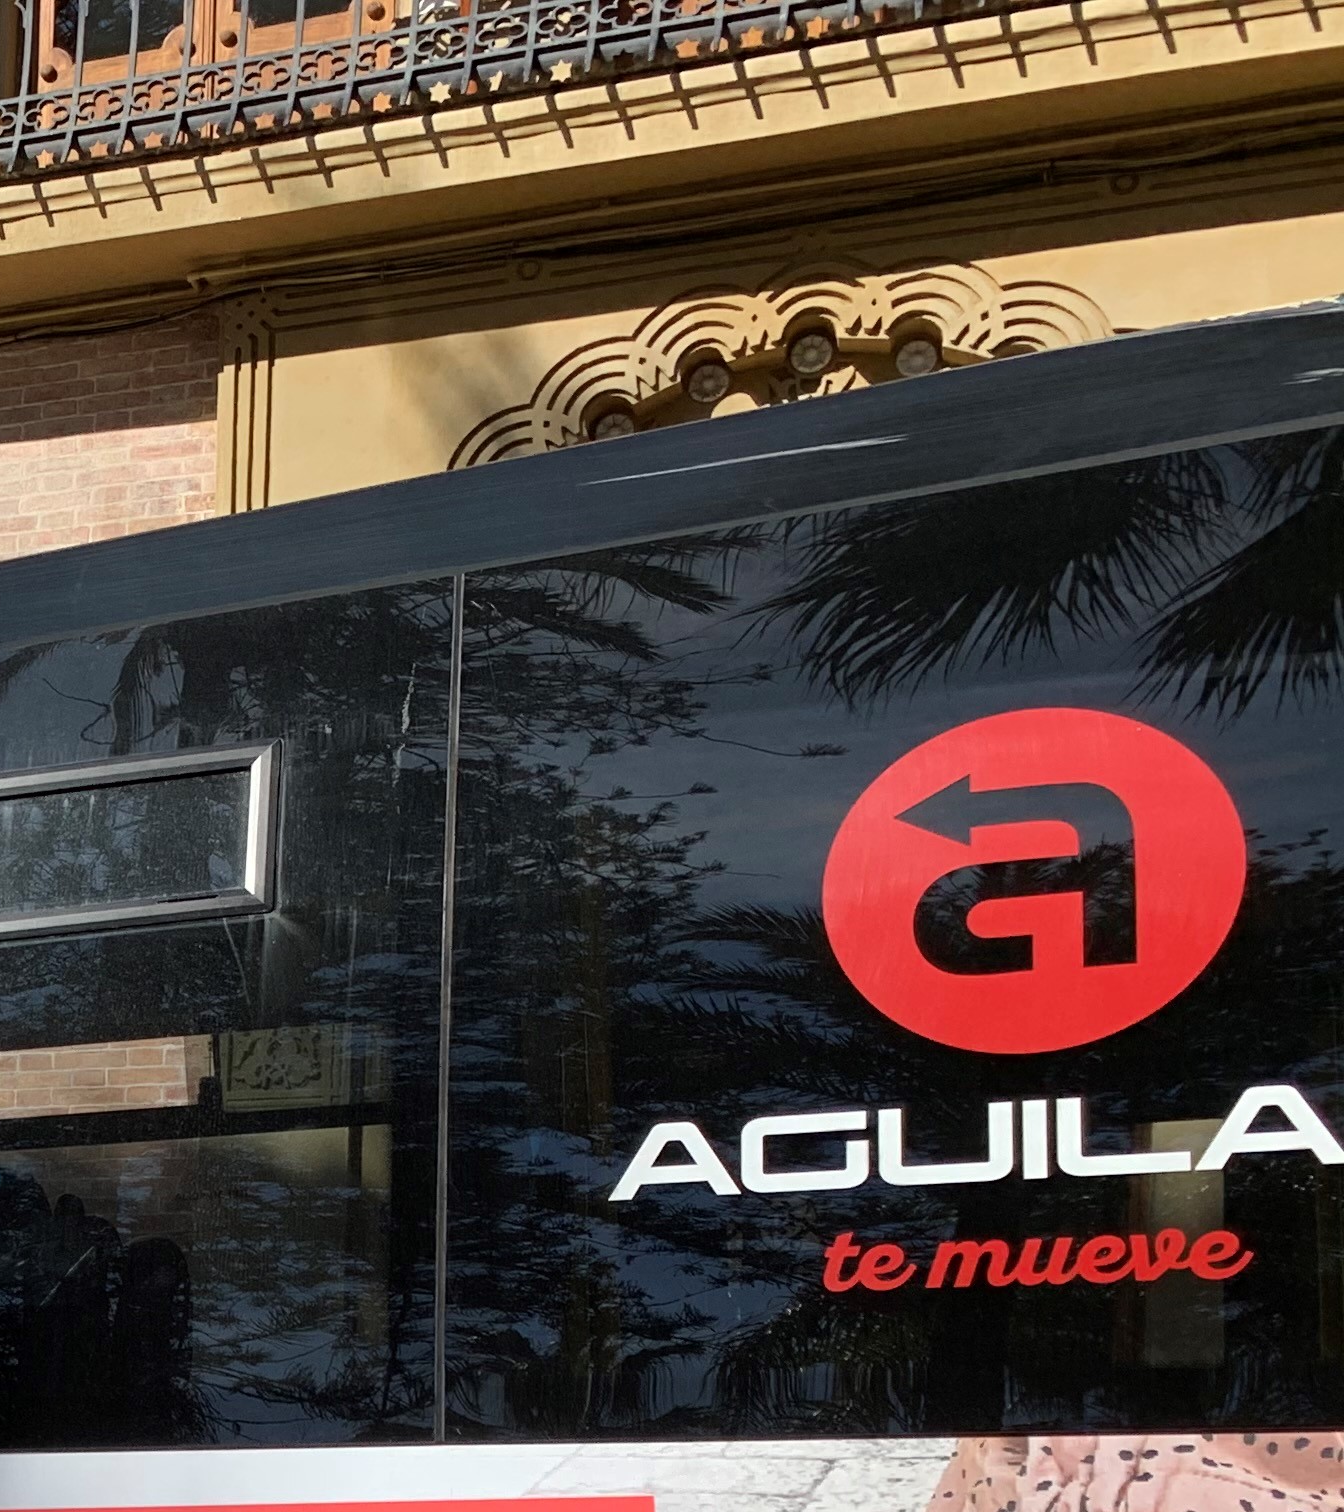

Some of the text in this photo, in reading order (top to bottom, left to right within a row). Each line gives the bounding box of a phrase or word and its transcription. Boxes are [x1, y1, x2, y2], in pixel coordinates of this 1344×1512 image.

[608, 1085, 1344, 1200] AGUILA
[822, 1227, 1254, 1293] te mueve
